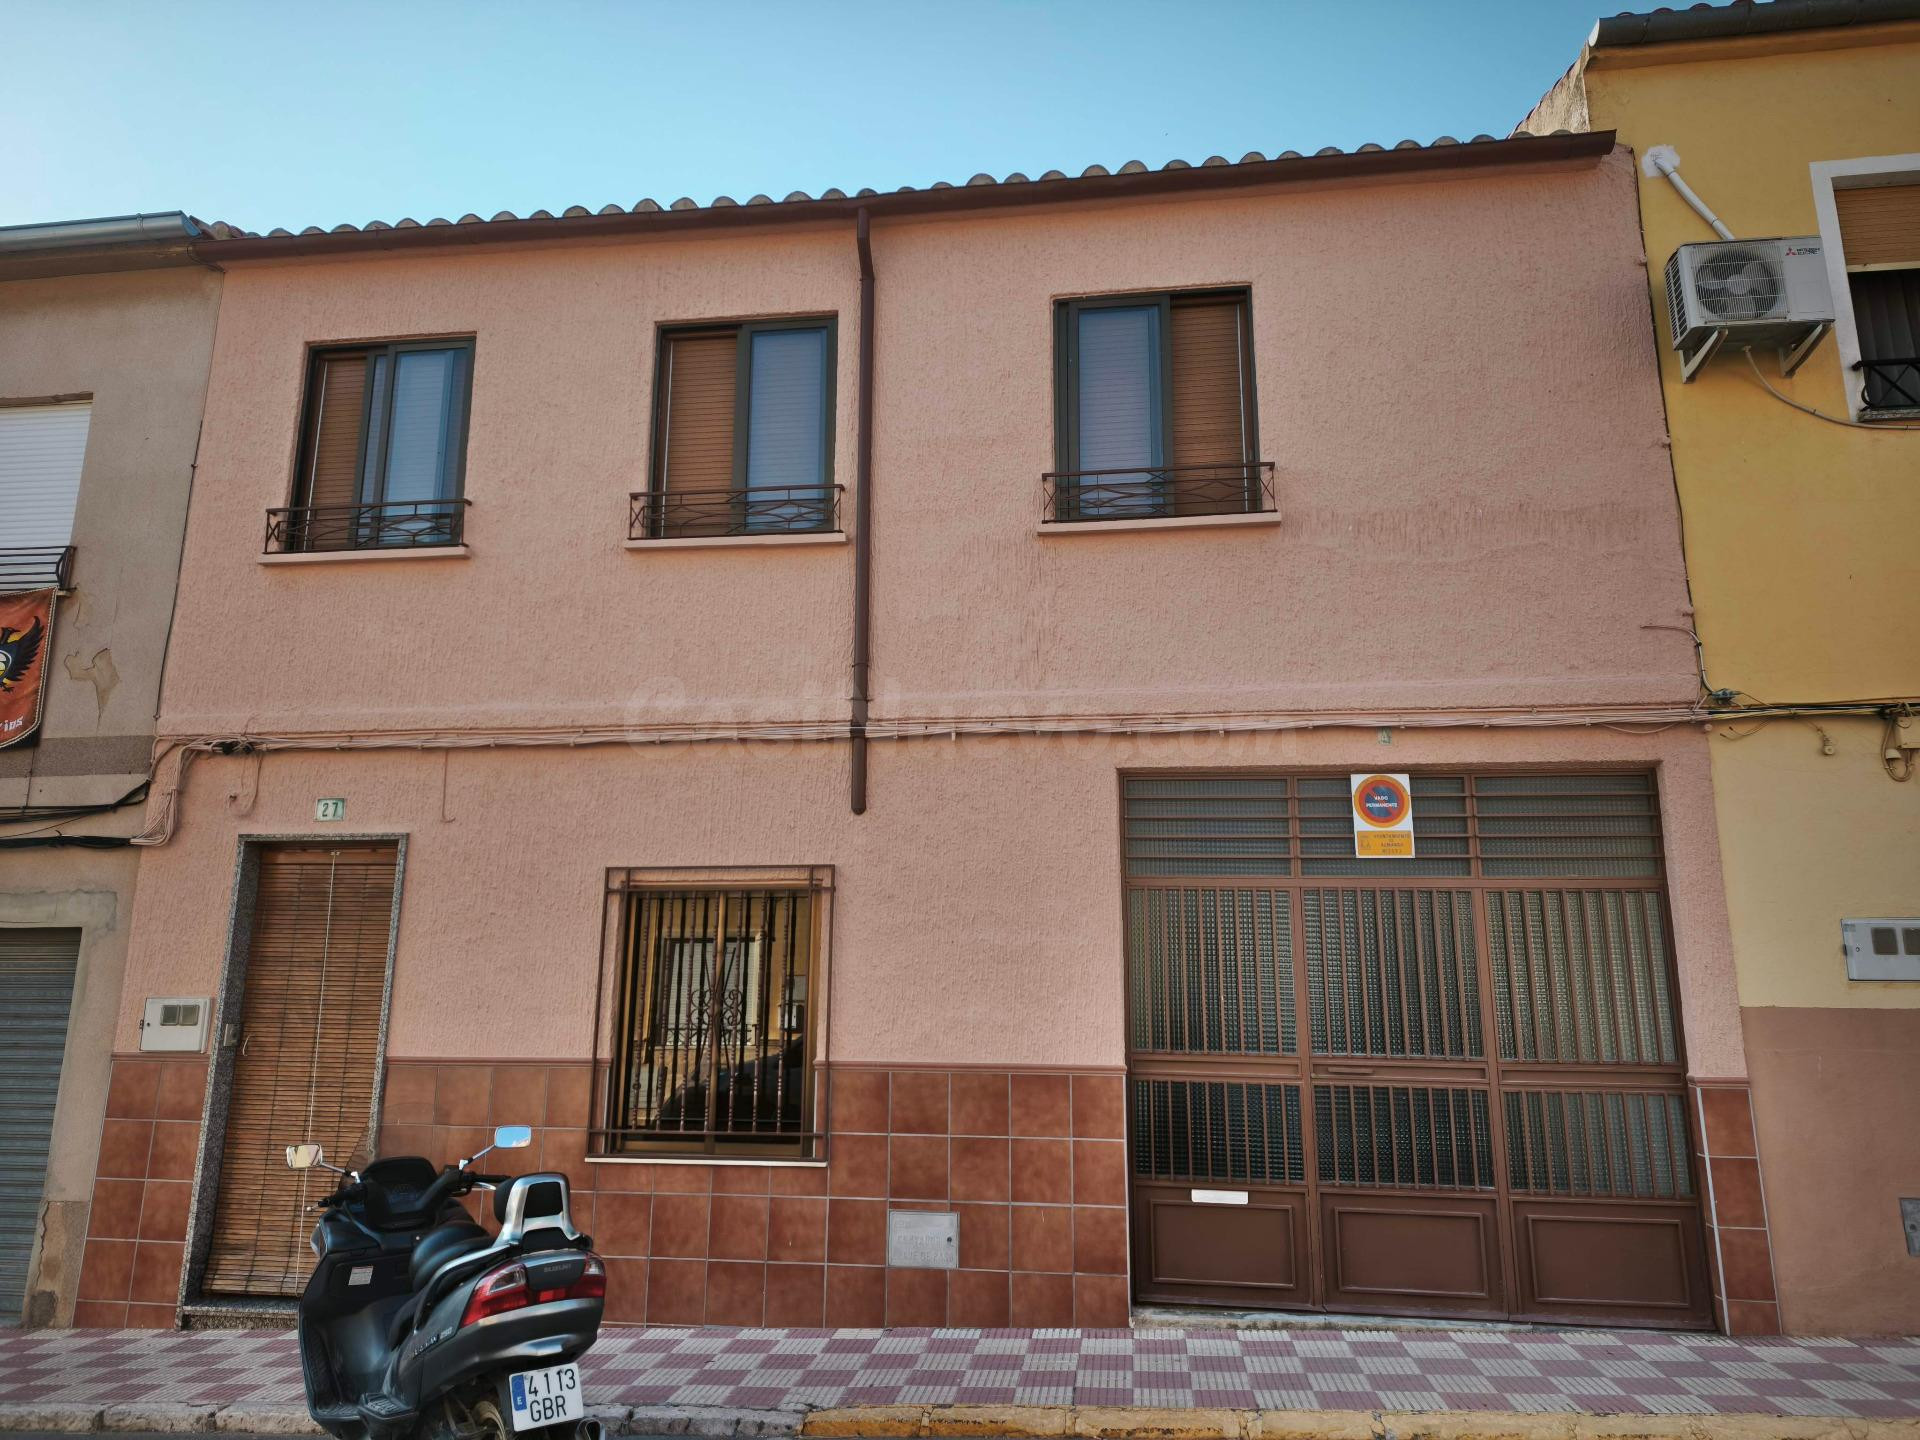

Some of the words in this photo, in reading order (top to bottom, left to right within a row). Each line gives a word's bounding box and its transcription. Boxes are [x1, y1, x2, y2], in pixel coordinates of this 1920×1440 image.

[322, 802, 338, 817] 27
[528, 1368, 576, 1397] 4113
[516, 1396, 523, 1406] E
[529, 1395, 567, 1423] GBR
